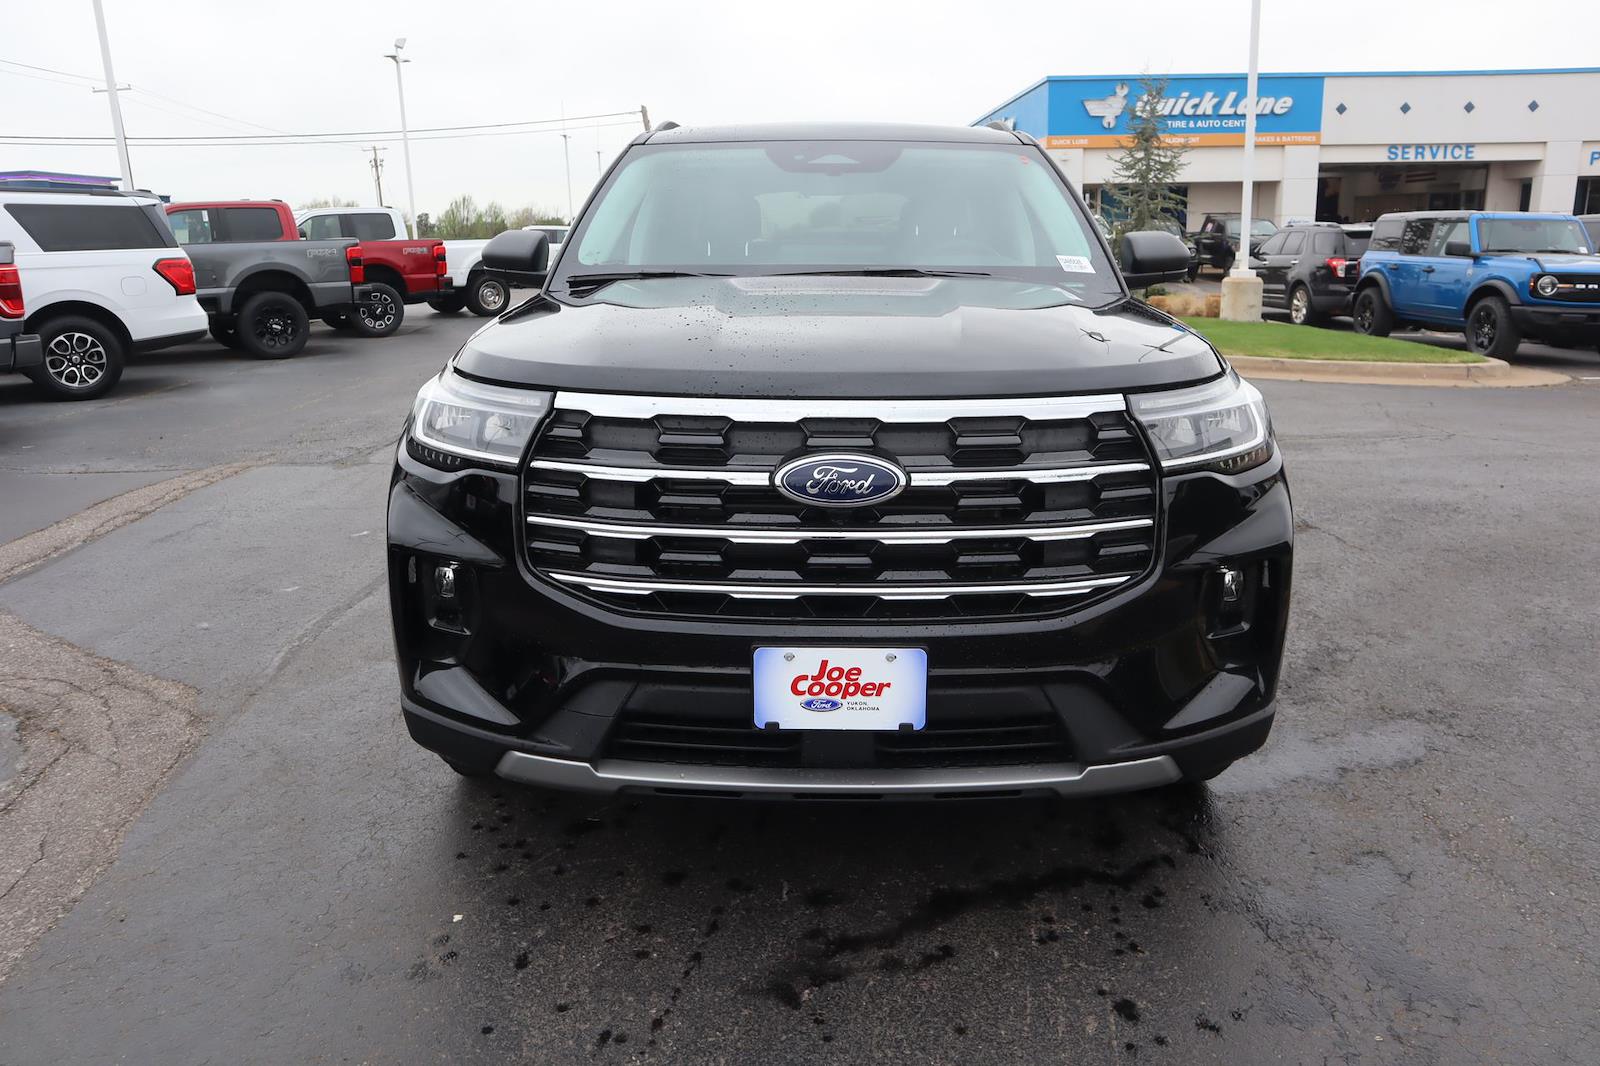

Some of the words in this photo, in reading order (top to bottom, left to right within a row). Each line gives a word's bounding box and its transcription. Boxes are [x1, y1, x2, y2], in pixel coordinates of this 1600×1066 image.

[1135, 91, 1218, 118] Quick
[1167, 120, 1187, 128] TIRE
[1189, 120, 1195, 128] &
[1196, 120, 1220, 128] AUTO
[1387, 145, 1475, 160] SERVICE
[806, 465, 876, 494] Ford
[811, 660, 862, 681] Joe
[790, 675, 891, 699] Cooper
